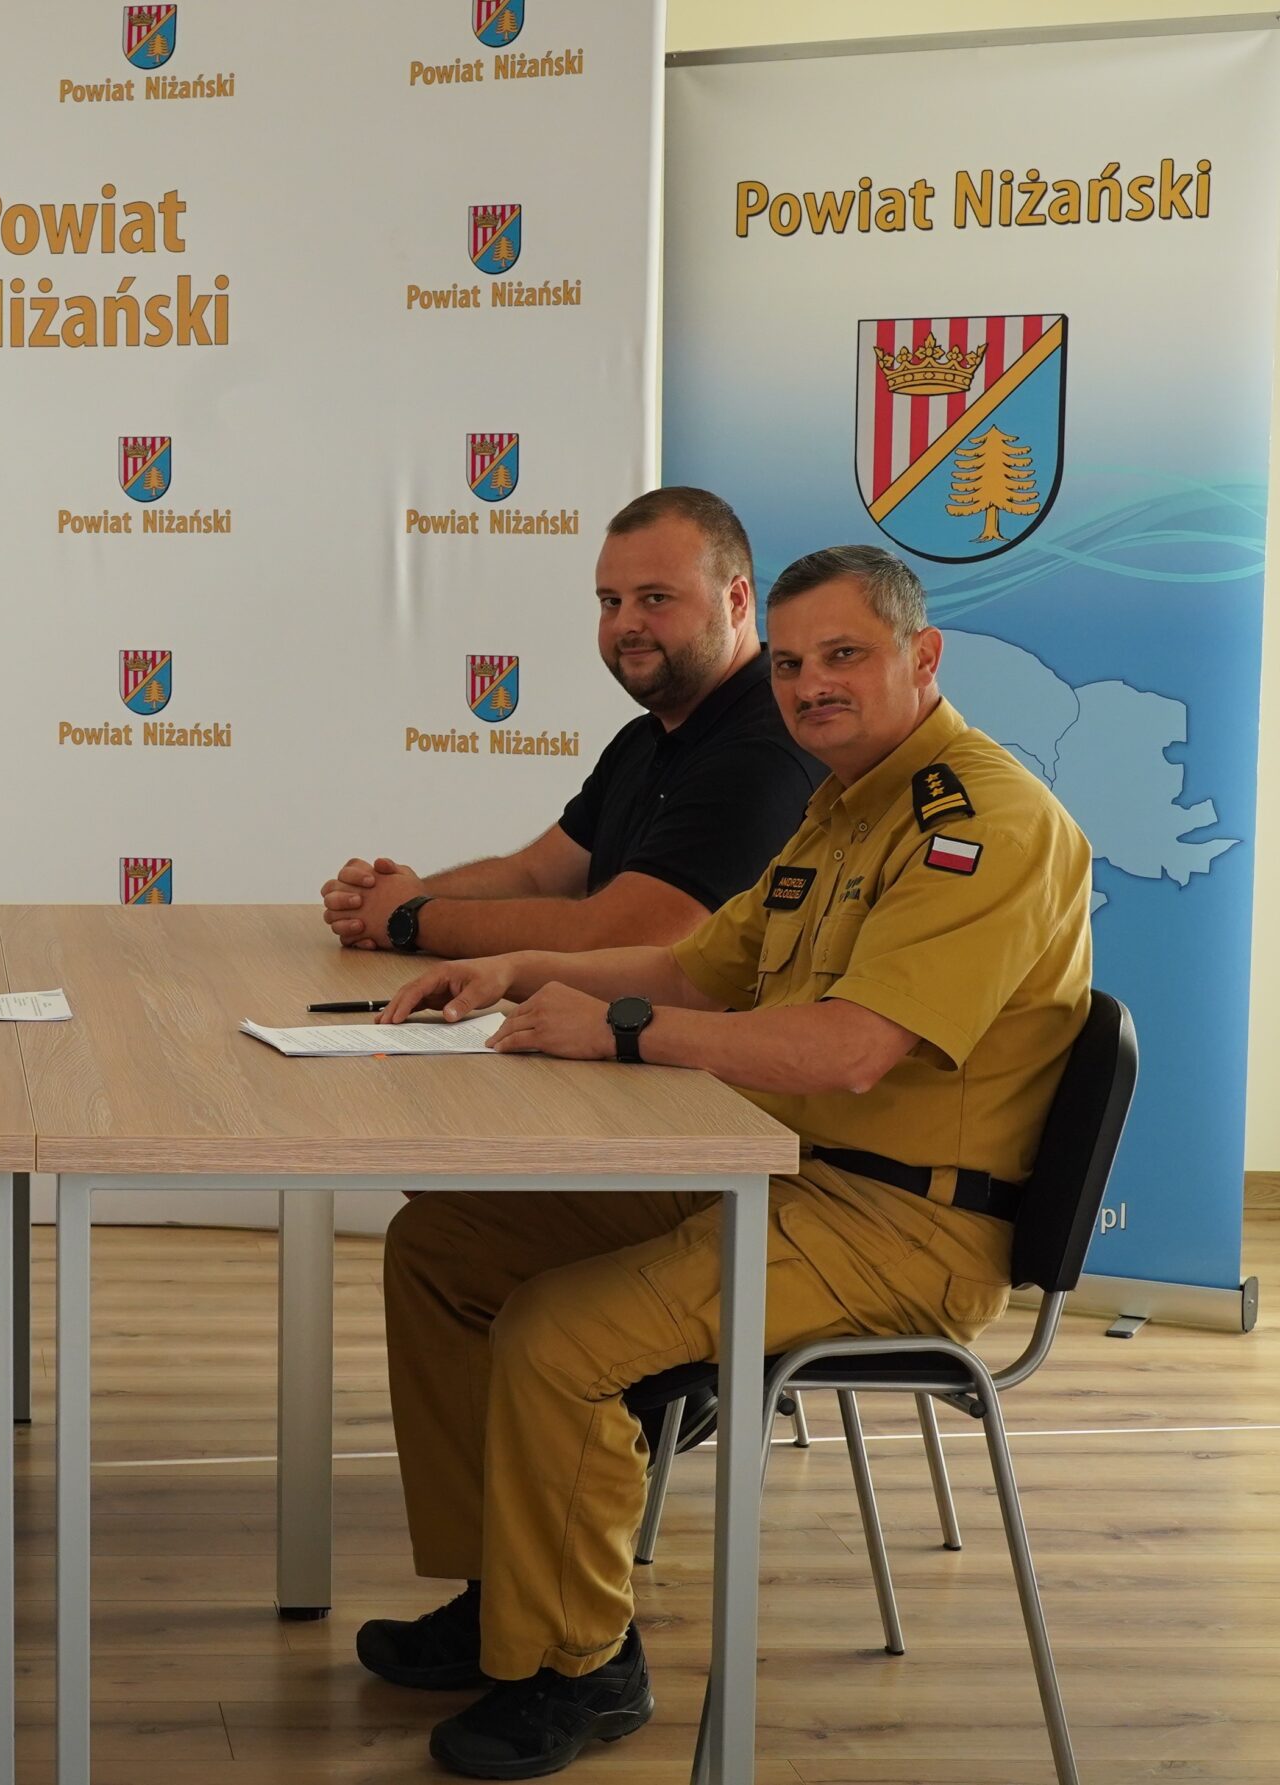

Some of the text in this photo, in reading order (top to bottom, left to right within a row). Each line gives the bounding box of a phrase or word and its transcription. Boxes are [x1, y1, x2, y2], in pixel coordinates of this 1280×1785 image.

[410, 48, 584, 85] Powiat Niżański
[59, 73, 235, 104] Powiat Niżański
[734, 158, 1212, 239] Powiat Niżański
[406, 279, 582, 310] Powiat Niżański
[57, 509, 232, 534] Powiat Niżański
[405, 508, 579, 535] Powiat Niżański
[58, 720, 233, 748] Powiat Niżański
[405, 727, 580, 757] Powiat Niżański
